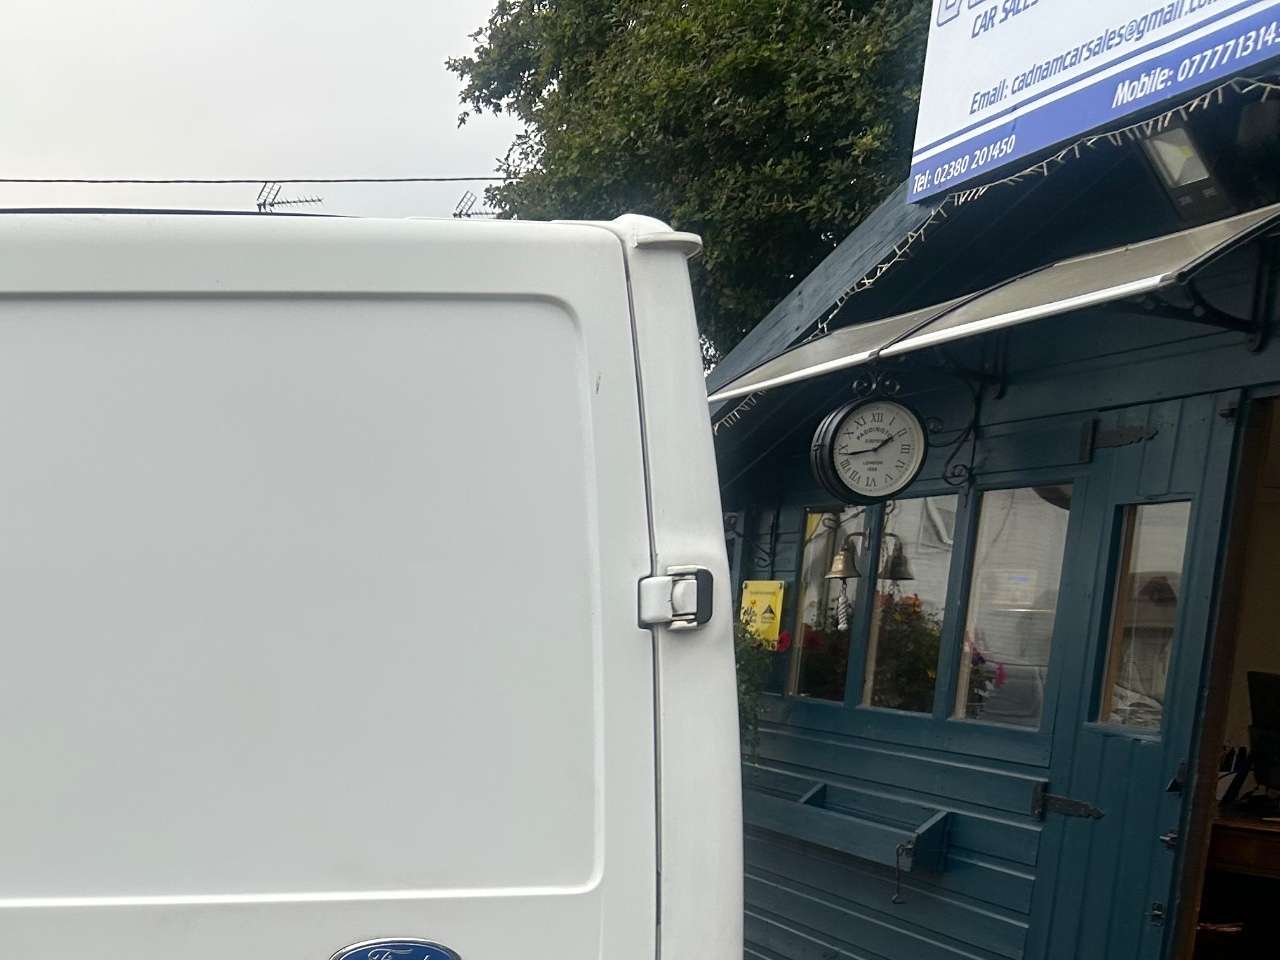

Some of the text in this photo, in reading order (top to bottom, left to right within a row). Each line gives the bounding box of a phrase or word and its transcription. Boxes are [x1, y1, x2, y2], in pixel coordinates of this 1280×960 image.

[971, 5, 998, 39] CAR
[969, 79, 1008, 115] Email:
[1011, 0, 1218, 95] cadnamcarsales@gmail.co
[1112, 67, 1173, 109] Mobile:
[913, 134, 1016, 194] Tel: 02380 201450
